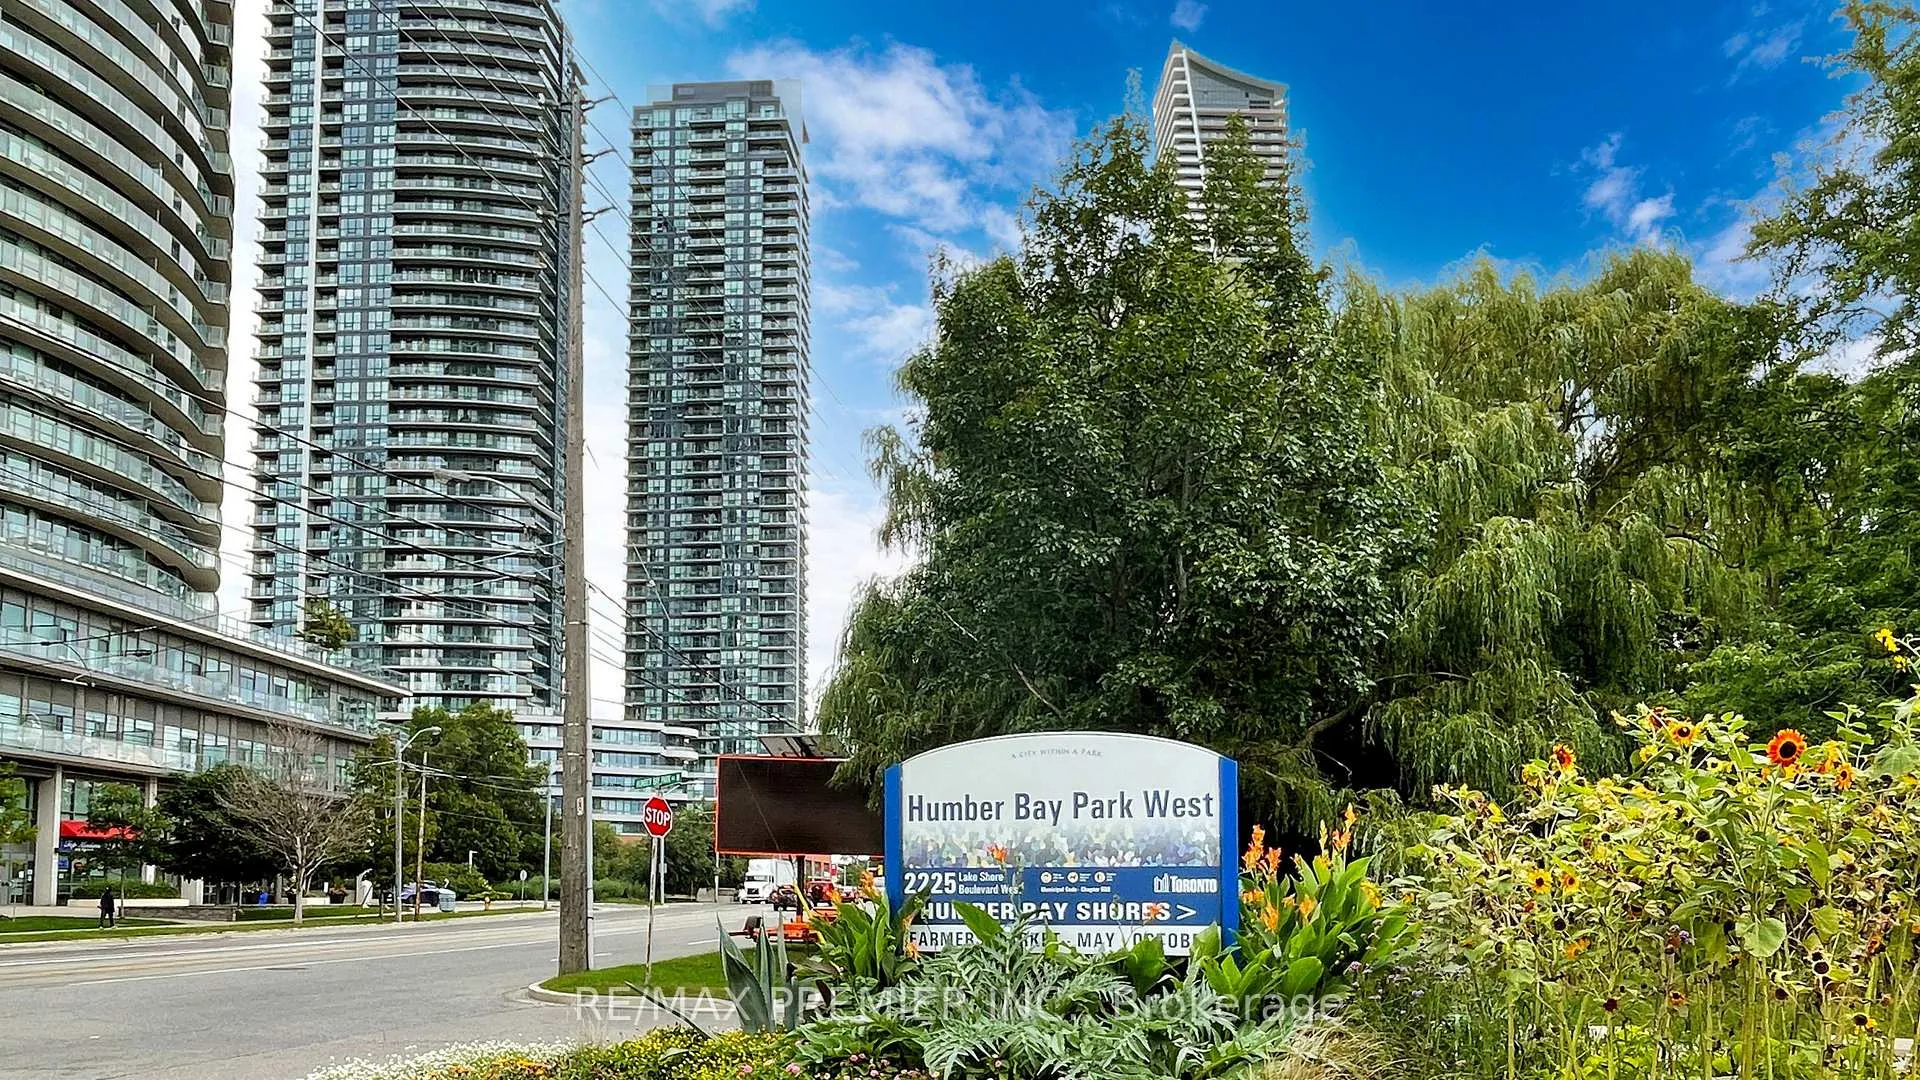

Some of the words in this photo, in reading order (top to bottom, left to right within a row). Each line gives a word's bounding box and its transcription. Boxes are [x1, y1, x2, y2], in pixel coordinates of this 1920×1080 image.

[1040, 748, 1069, 757] WITHIN
[1081, 749, 1102, 757] PARK
[908, 793, 1004, 822] Humber
[1014, 792, 1062, 826] Bay
[1073, 791, 1133, 819] Park
[1143, 789, 1214, 818] West
[645, 807, 670, 827] STOP
[904, 872, 957, 894] 2225
[958, 872, 978, 882] Lake
[979, 871, 1005, 882] Shore
[1170, 876, 1218, 893] TORONTO
[958, 884, 999, 894] Boulevard
[1001, 884, 1022, 895] Wes
[921, 902, 1016, 920] HUER
[1076, 902, 1171, 920] SHORES
[909, 931, 983, 947] FARMER
[1077, 932, 1115, 947] MAY
